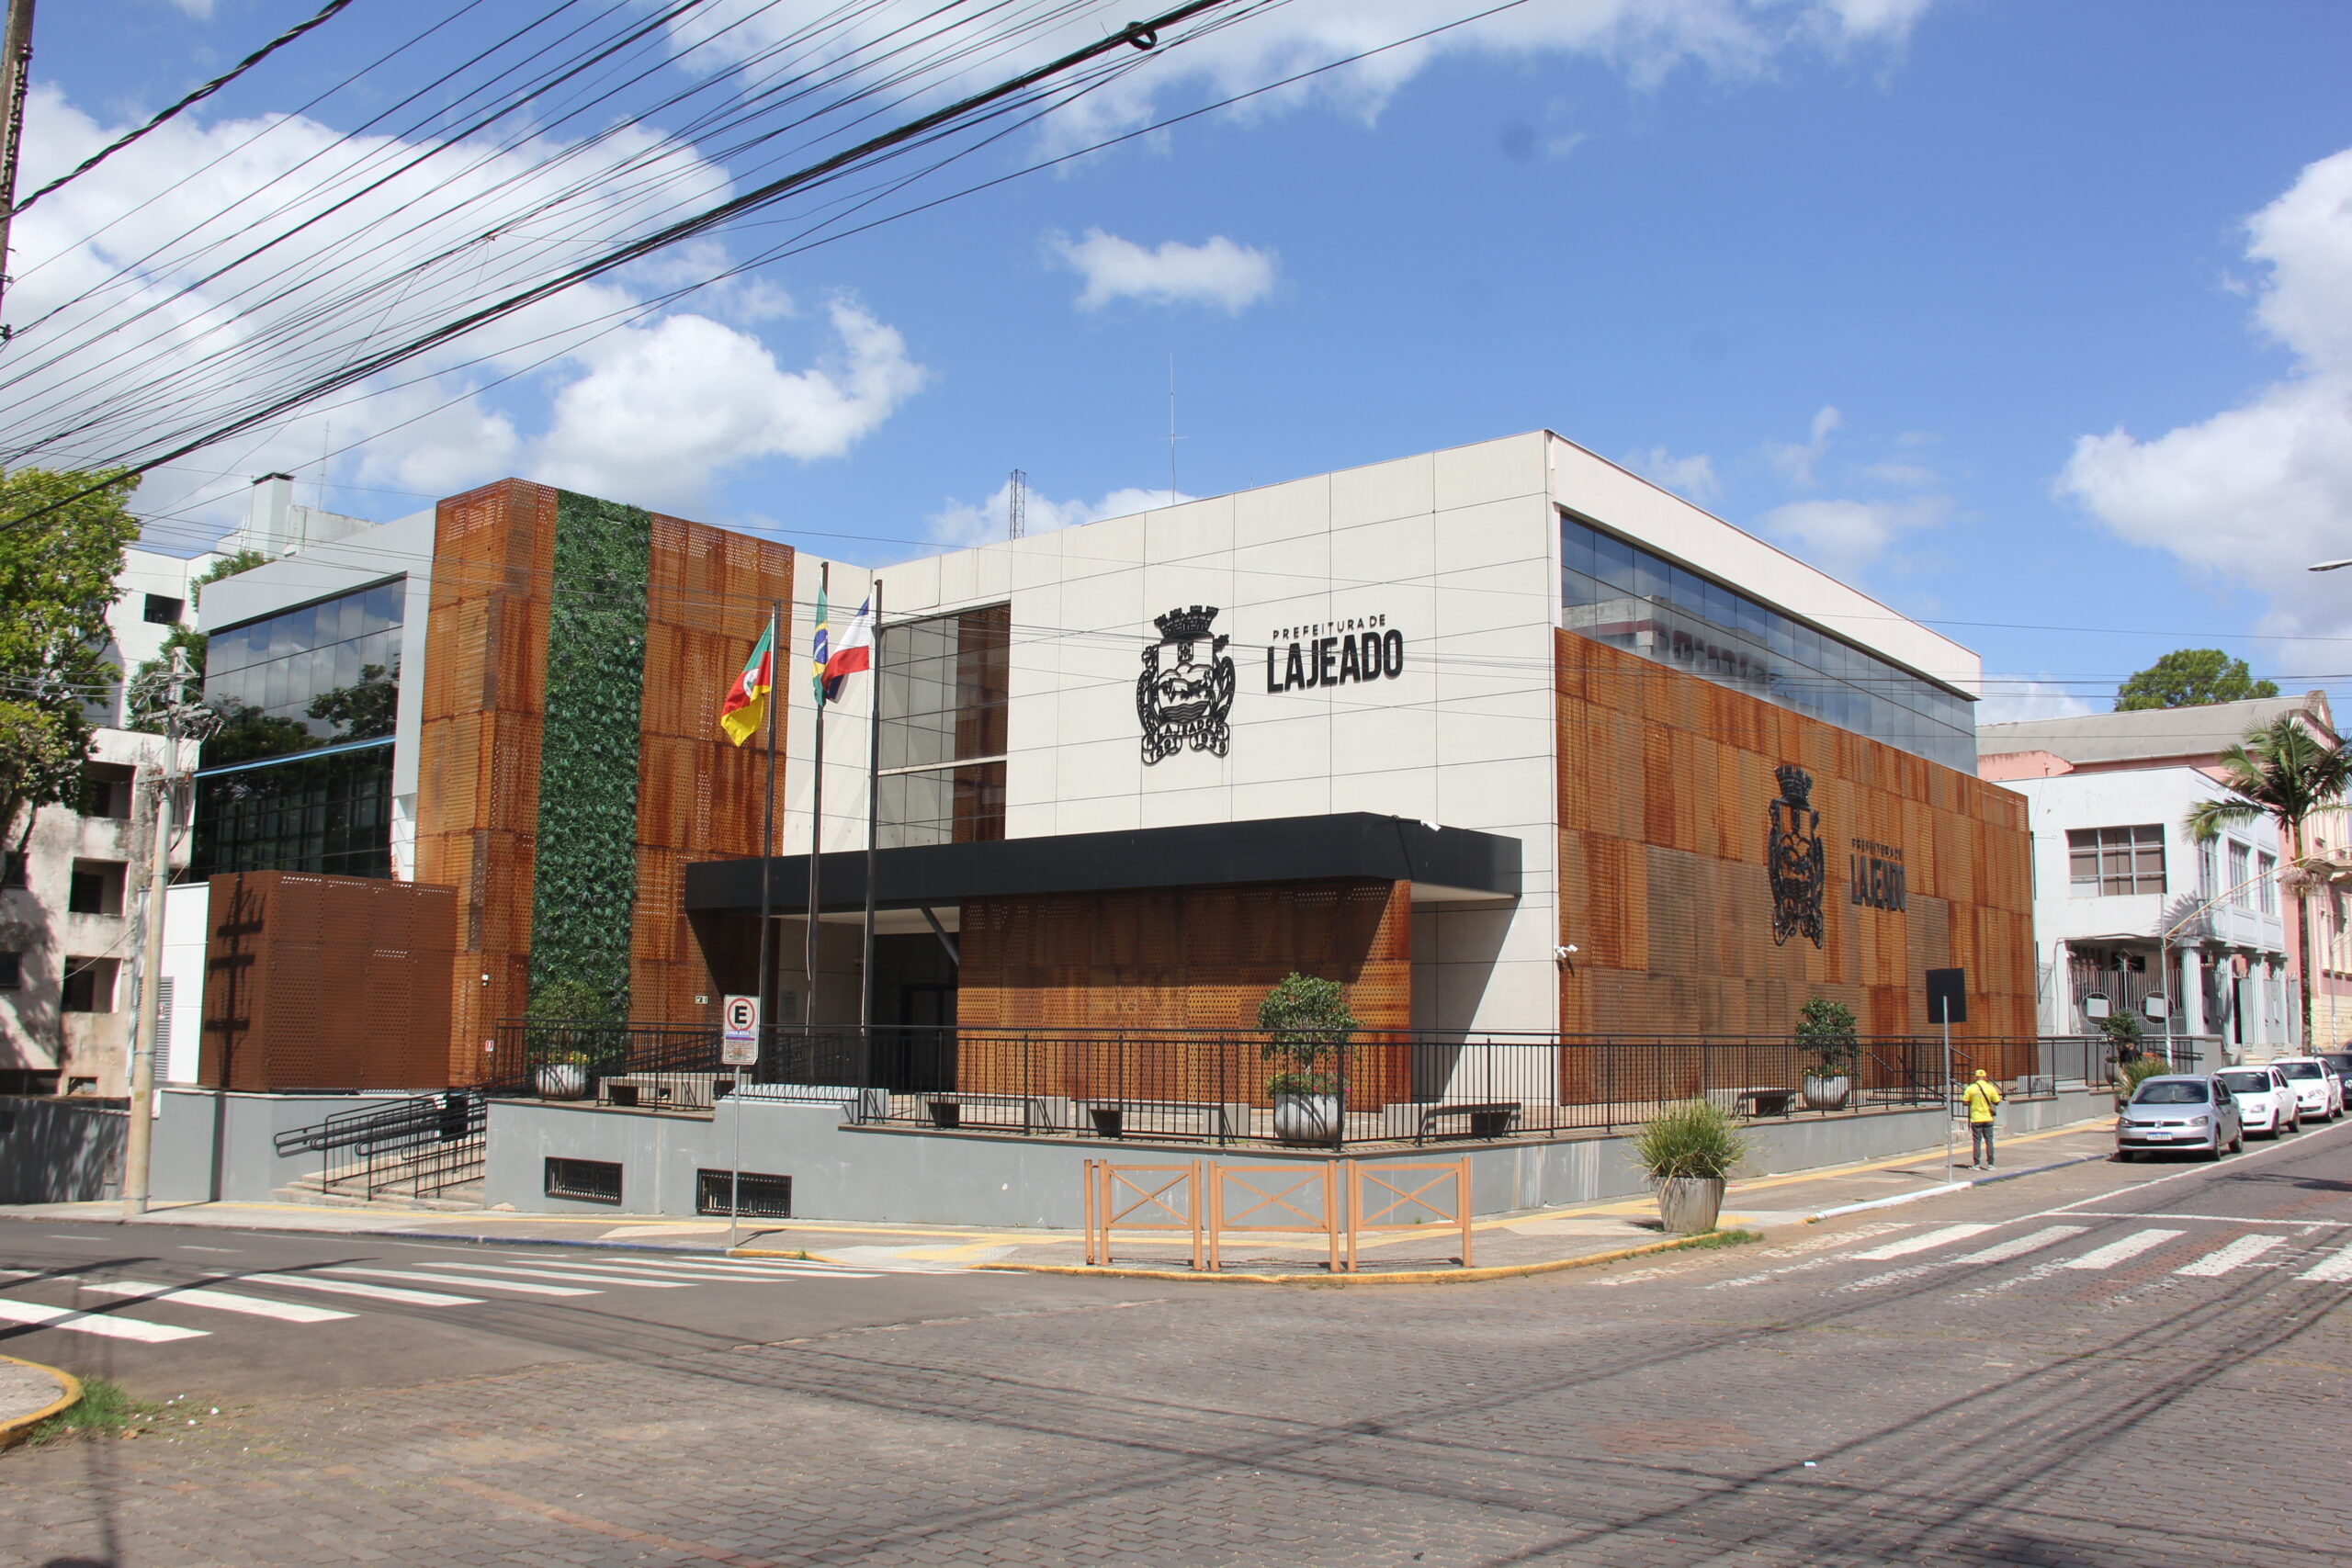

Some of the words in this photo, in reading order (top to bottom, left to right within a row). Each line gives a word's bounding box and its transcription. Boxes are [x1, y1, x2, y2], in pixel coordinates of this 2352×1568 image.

[1272, 617, 1365, 641] PREFEITURA
[1369, 615, 1385, 628] DE
[1267, 629, 1403, 694] LAJEADO
[1157, 718, 1215, 737] LAJEADO
[1851, 854, 1905, 912] LAJEADO
[735, 1006, 747, 1023] E
